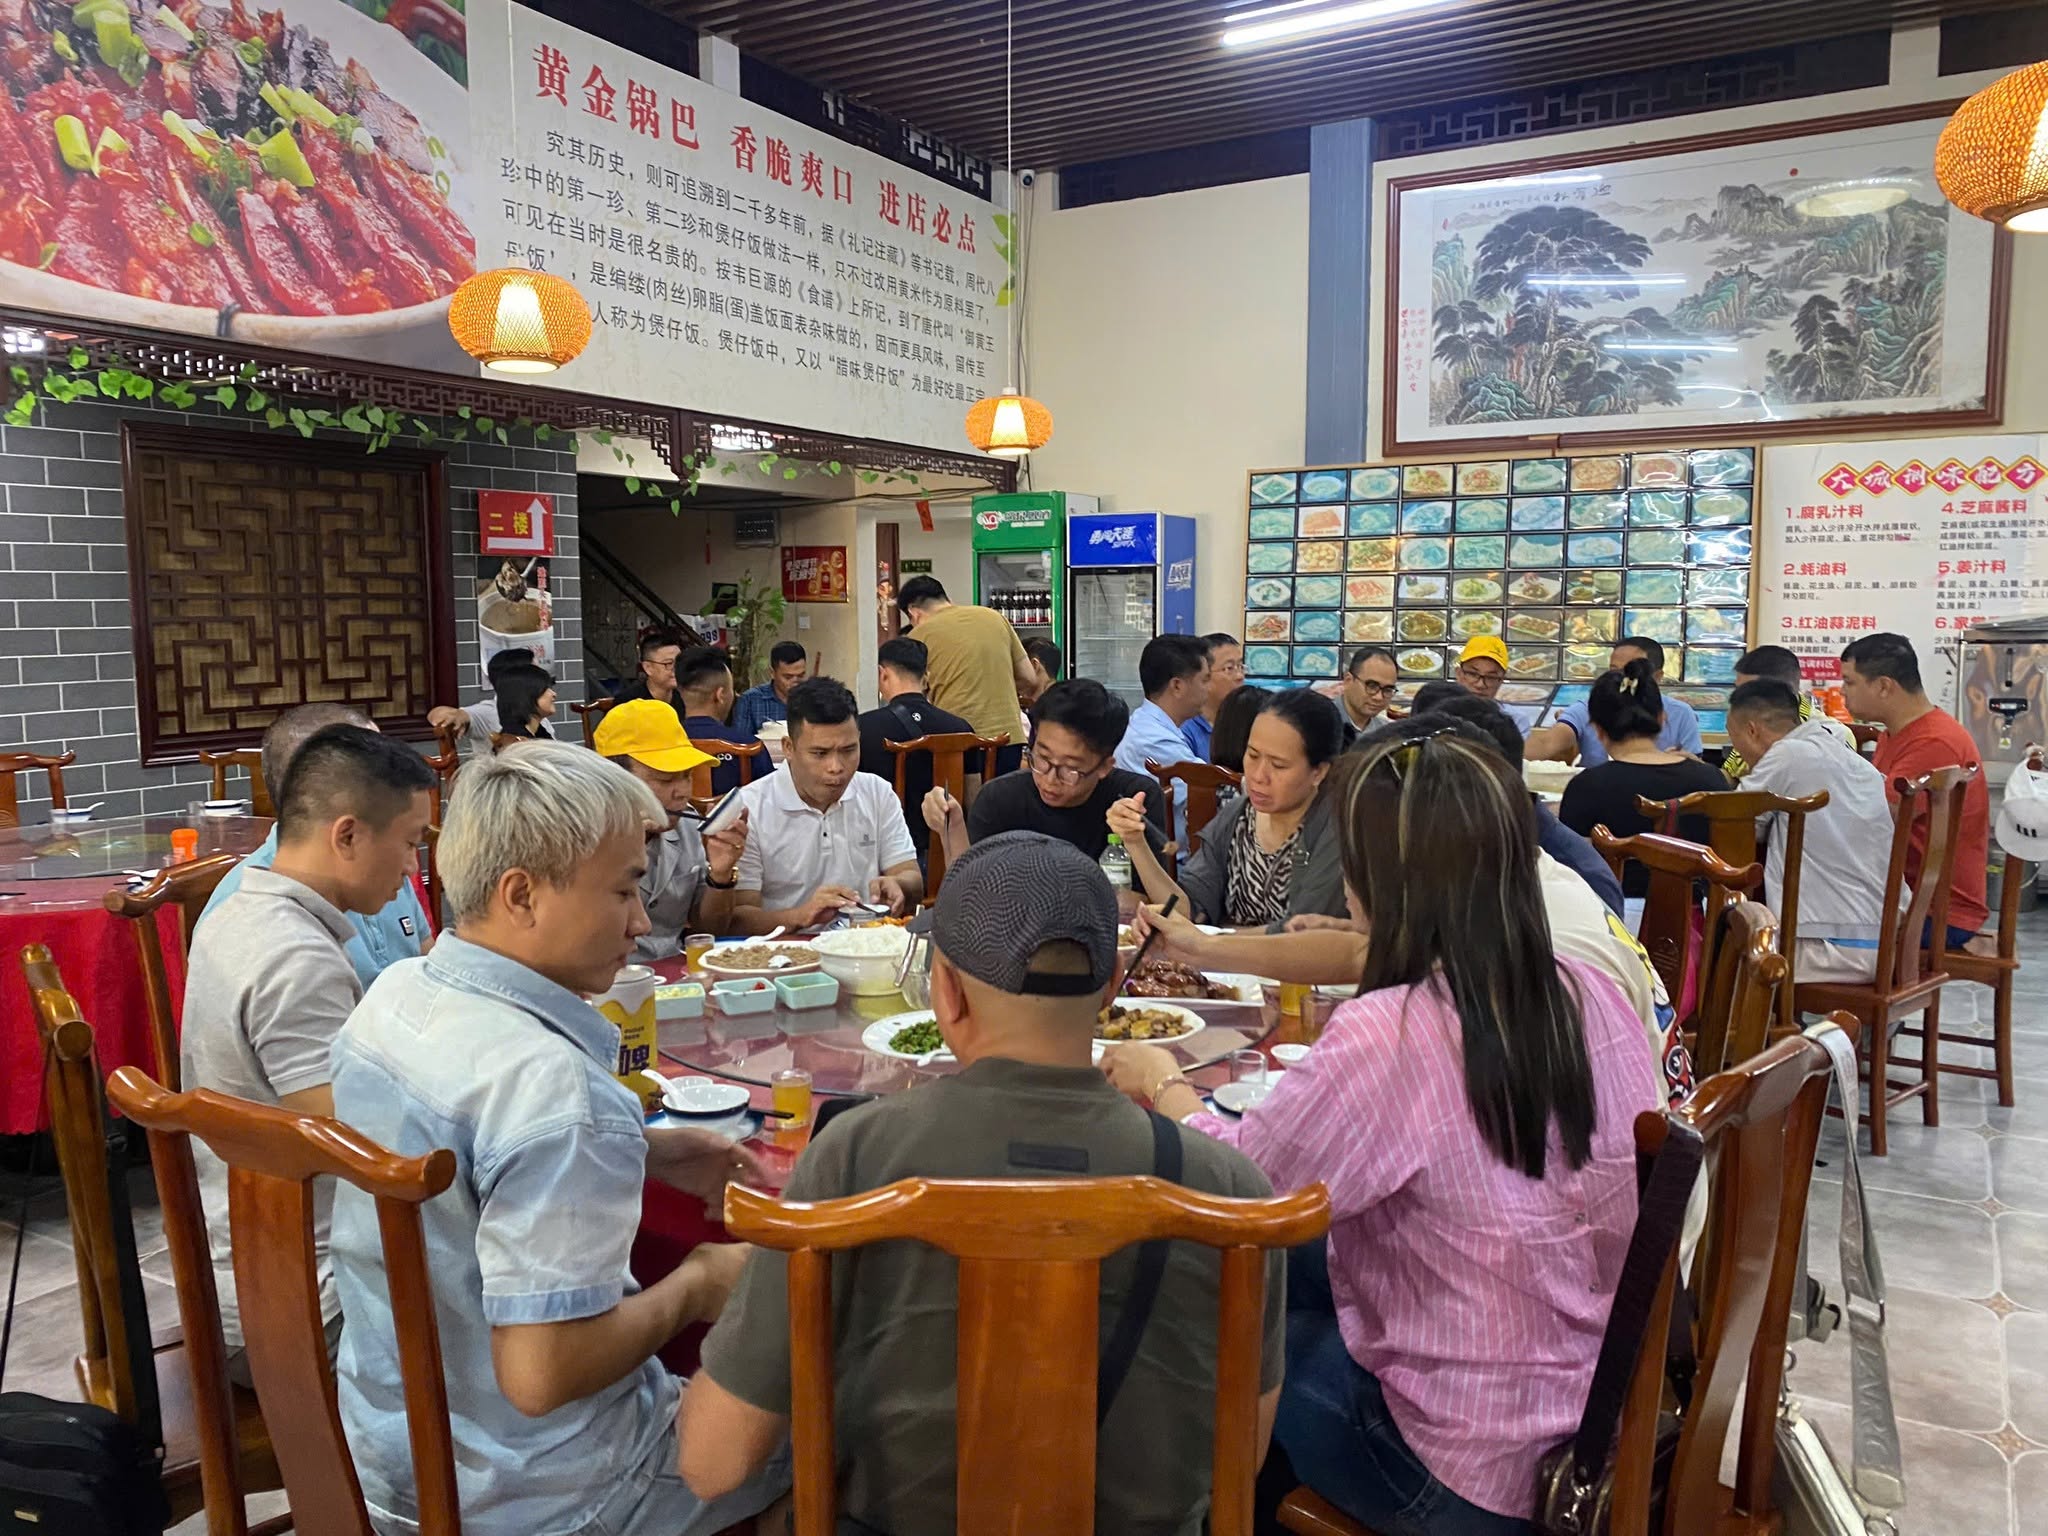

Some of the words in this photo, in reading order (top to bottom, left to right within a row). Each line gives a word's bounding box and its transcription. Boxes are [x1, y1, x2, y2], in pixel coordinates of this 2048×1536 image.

[533, 44, 700, 149] 黄金锅巴
[731, 126, 853, 205] 香脆爽口
[879, 179, 976, 254] 进店必点
[488, 512, 528, 535] 二楼
[1784, 561, 1847, 576] 2.蚝油料
[1938, 559, 2006, 575] 5.姜汁料
[1781, 616, 1877, 630] 3.红油蒜泥料
